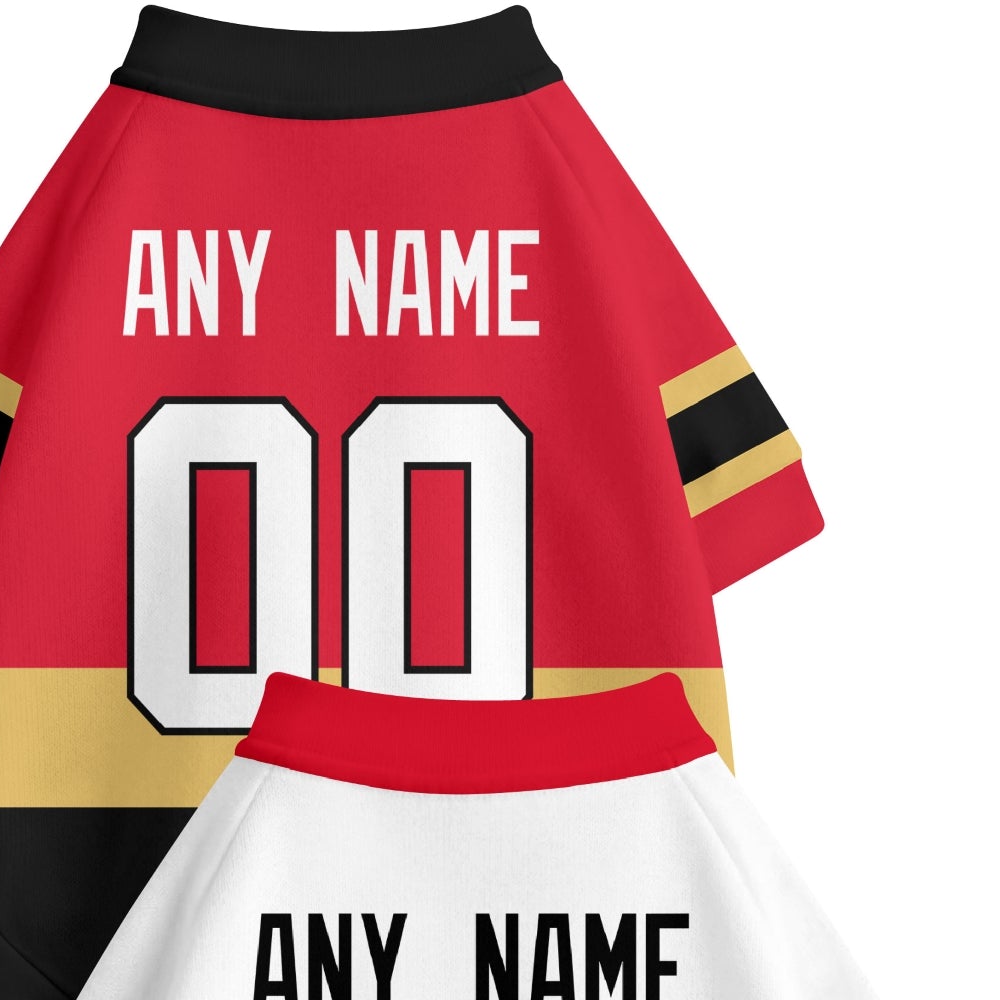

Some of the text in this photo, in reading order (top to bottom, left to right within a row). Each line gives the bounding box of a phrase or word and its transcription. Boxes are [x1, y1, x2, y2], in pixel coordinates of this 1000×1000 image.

[123, 230, 539, 335] ANY NAME
[127, 396, 533, 735] 00
